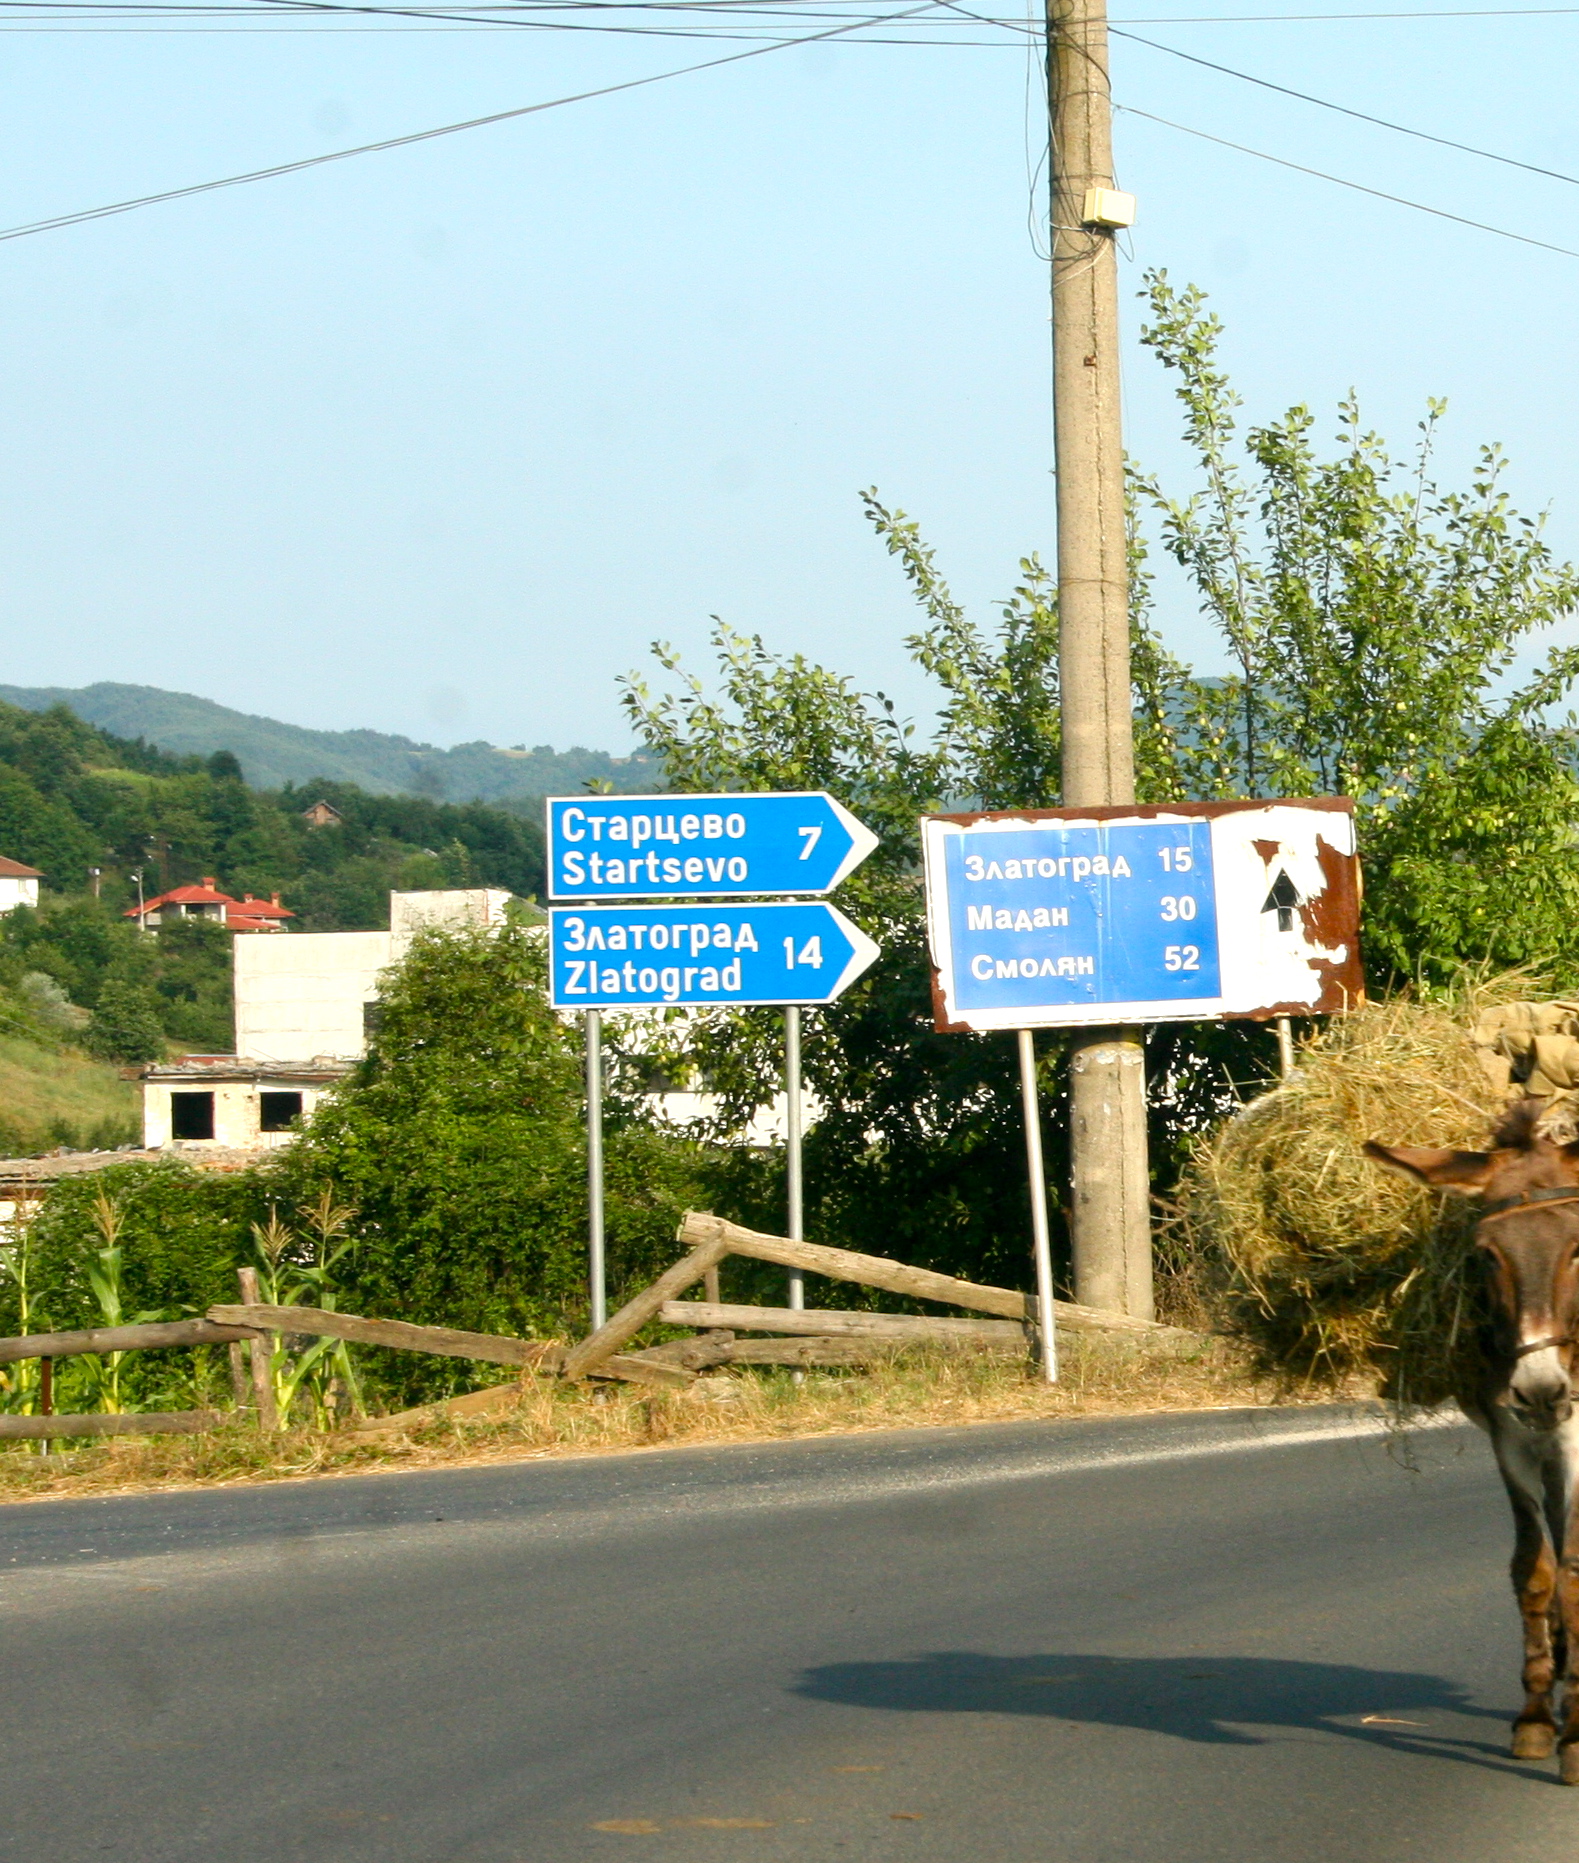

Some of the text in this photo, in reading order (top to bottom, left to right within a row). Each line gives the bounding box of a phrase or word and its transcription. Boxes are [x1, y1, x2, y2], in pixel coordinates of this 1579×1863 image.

[562, 807, 746, 849] Старцево
[799, 826, 822, 861] 7
[562, 850, 748, 886] Startsevo
[965, 846, 1194, 883] Златоград 15
[966, 895, 1197, 932] Мадан 30
[563, 917, 759, 958] Златоград
[783, 935, 824, 970] 14
[564, 957, 742, 1002] Zlatograd
[970, 944, 1200, 981] Смолян 52
